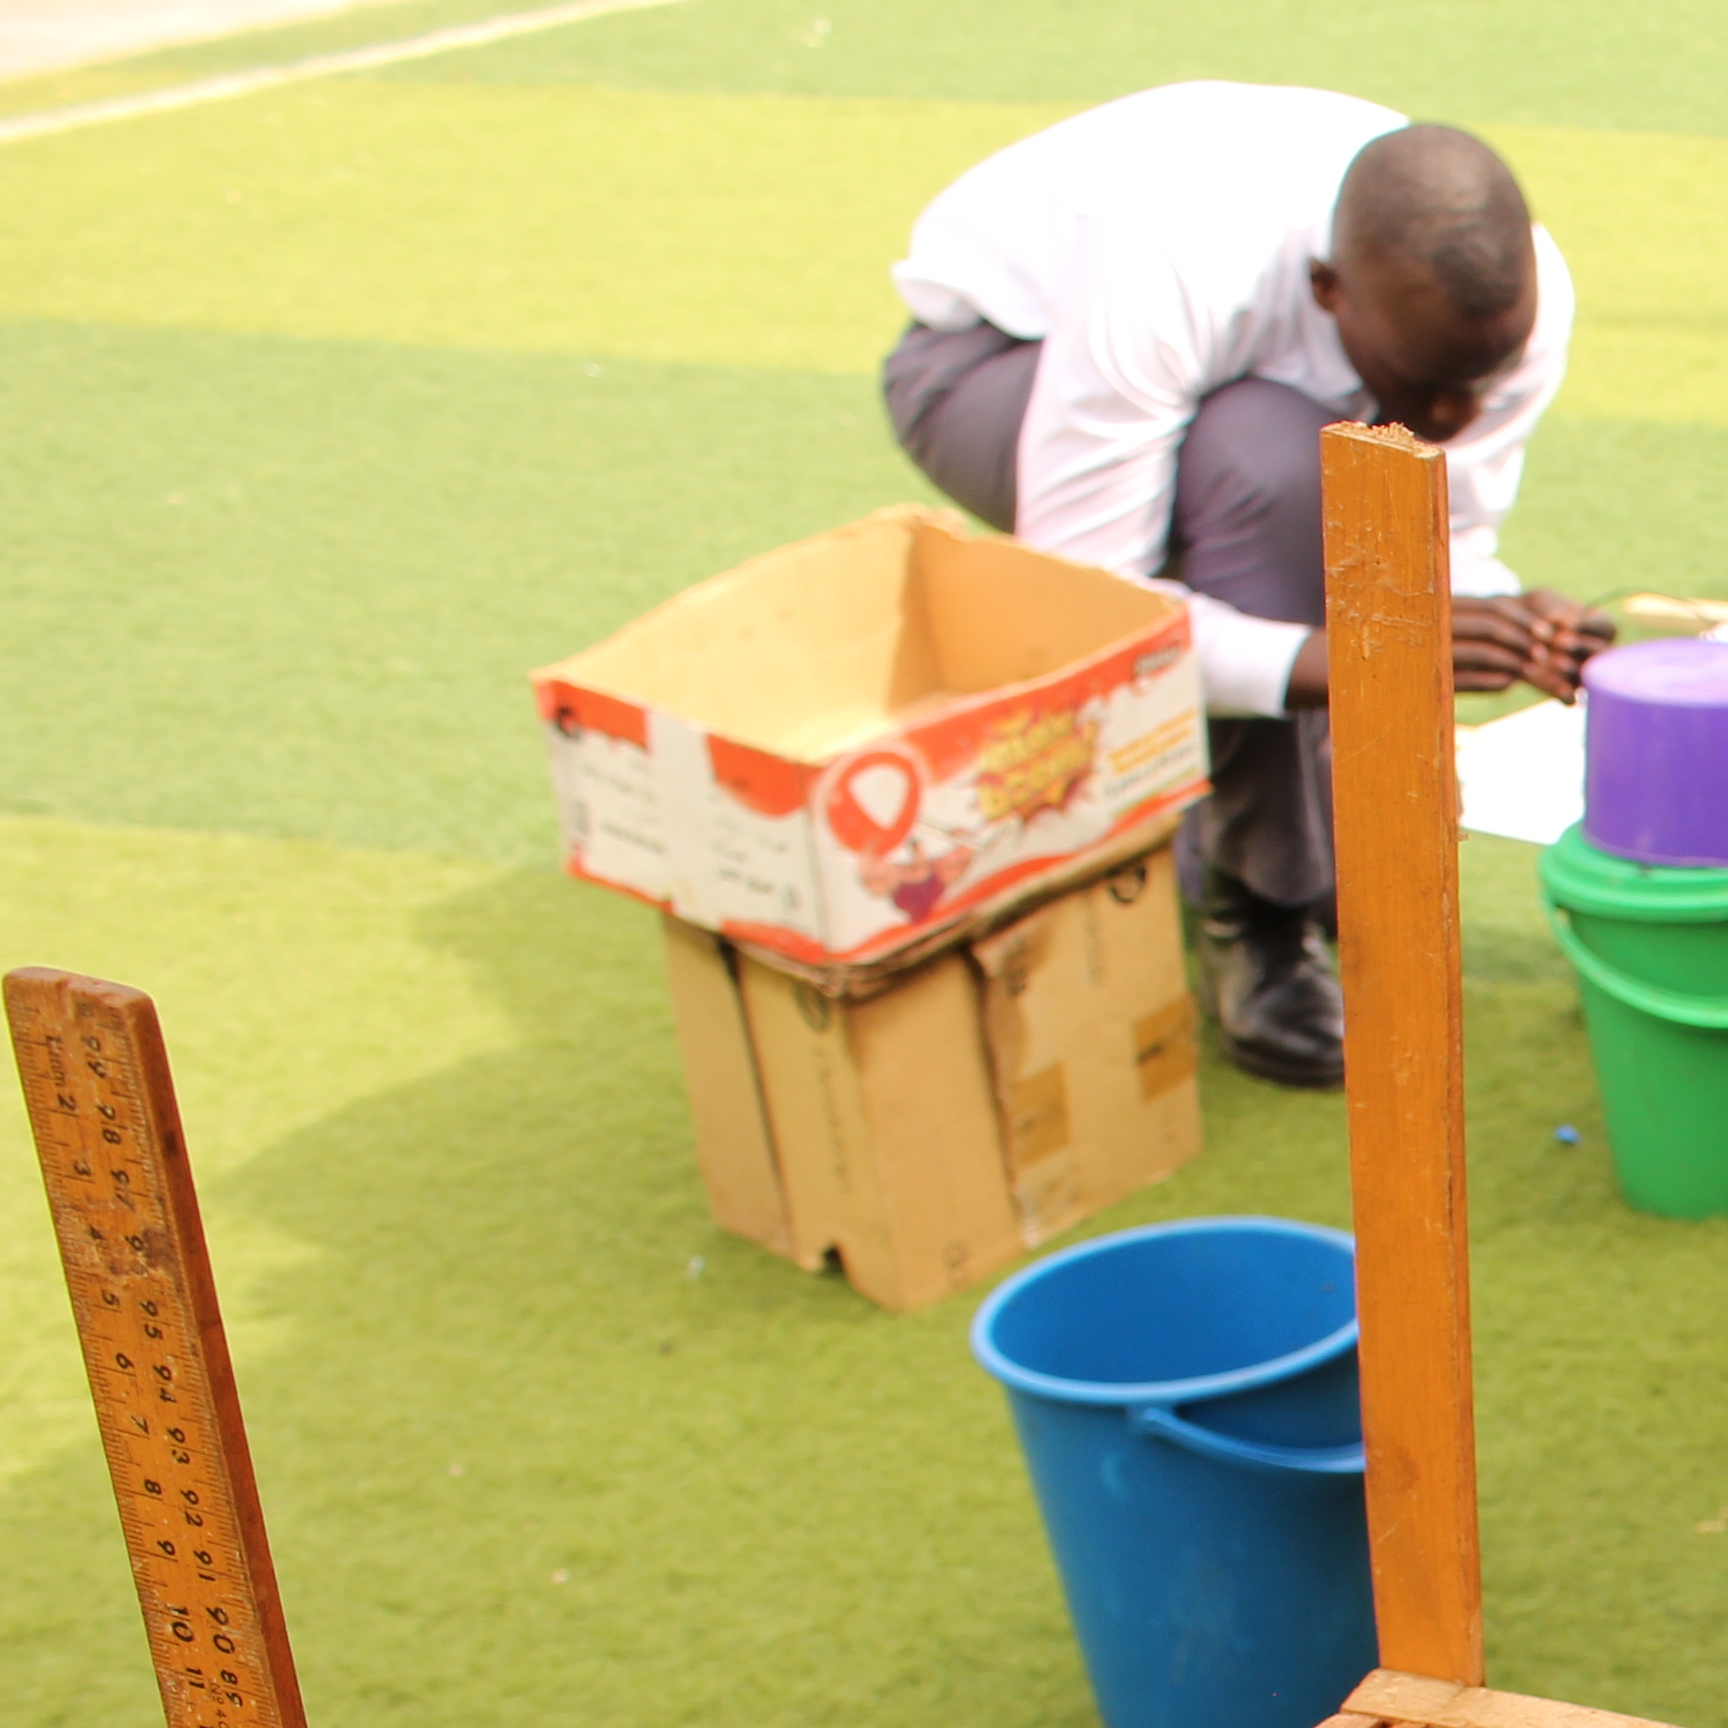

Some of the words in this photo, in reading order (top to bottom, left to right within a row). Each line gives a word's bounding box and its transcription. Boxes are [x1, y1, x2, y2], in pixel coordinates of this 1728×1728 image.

[58, 1092, 77, 1111] 2
[74, 1160, 92, 1176] 3
[102, 1290, 120, 1306] 5
[115, 1352, 134, 1370] 6
[130, 1416, 149, 1434] 7
[144, 1479, 162, 1495] 8
[157, 1540, 176, 1556] 9
[168, 1604, 195, 1643] 10
[186, 1666, 206, 1690] 11
[98, 1103, 121, 1145] 98
[140, 1300, 164, 1341] 95
[153, 1364, 177, 1404] 94
[168, 1427, 191, 1464] 93
[181, 1489, 203, 1527] 92
[194, 1550, 216, 1582] 91
[206, 1606, 235, 1655] 90
[221, 1669, 243, 1708] 89
